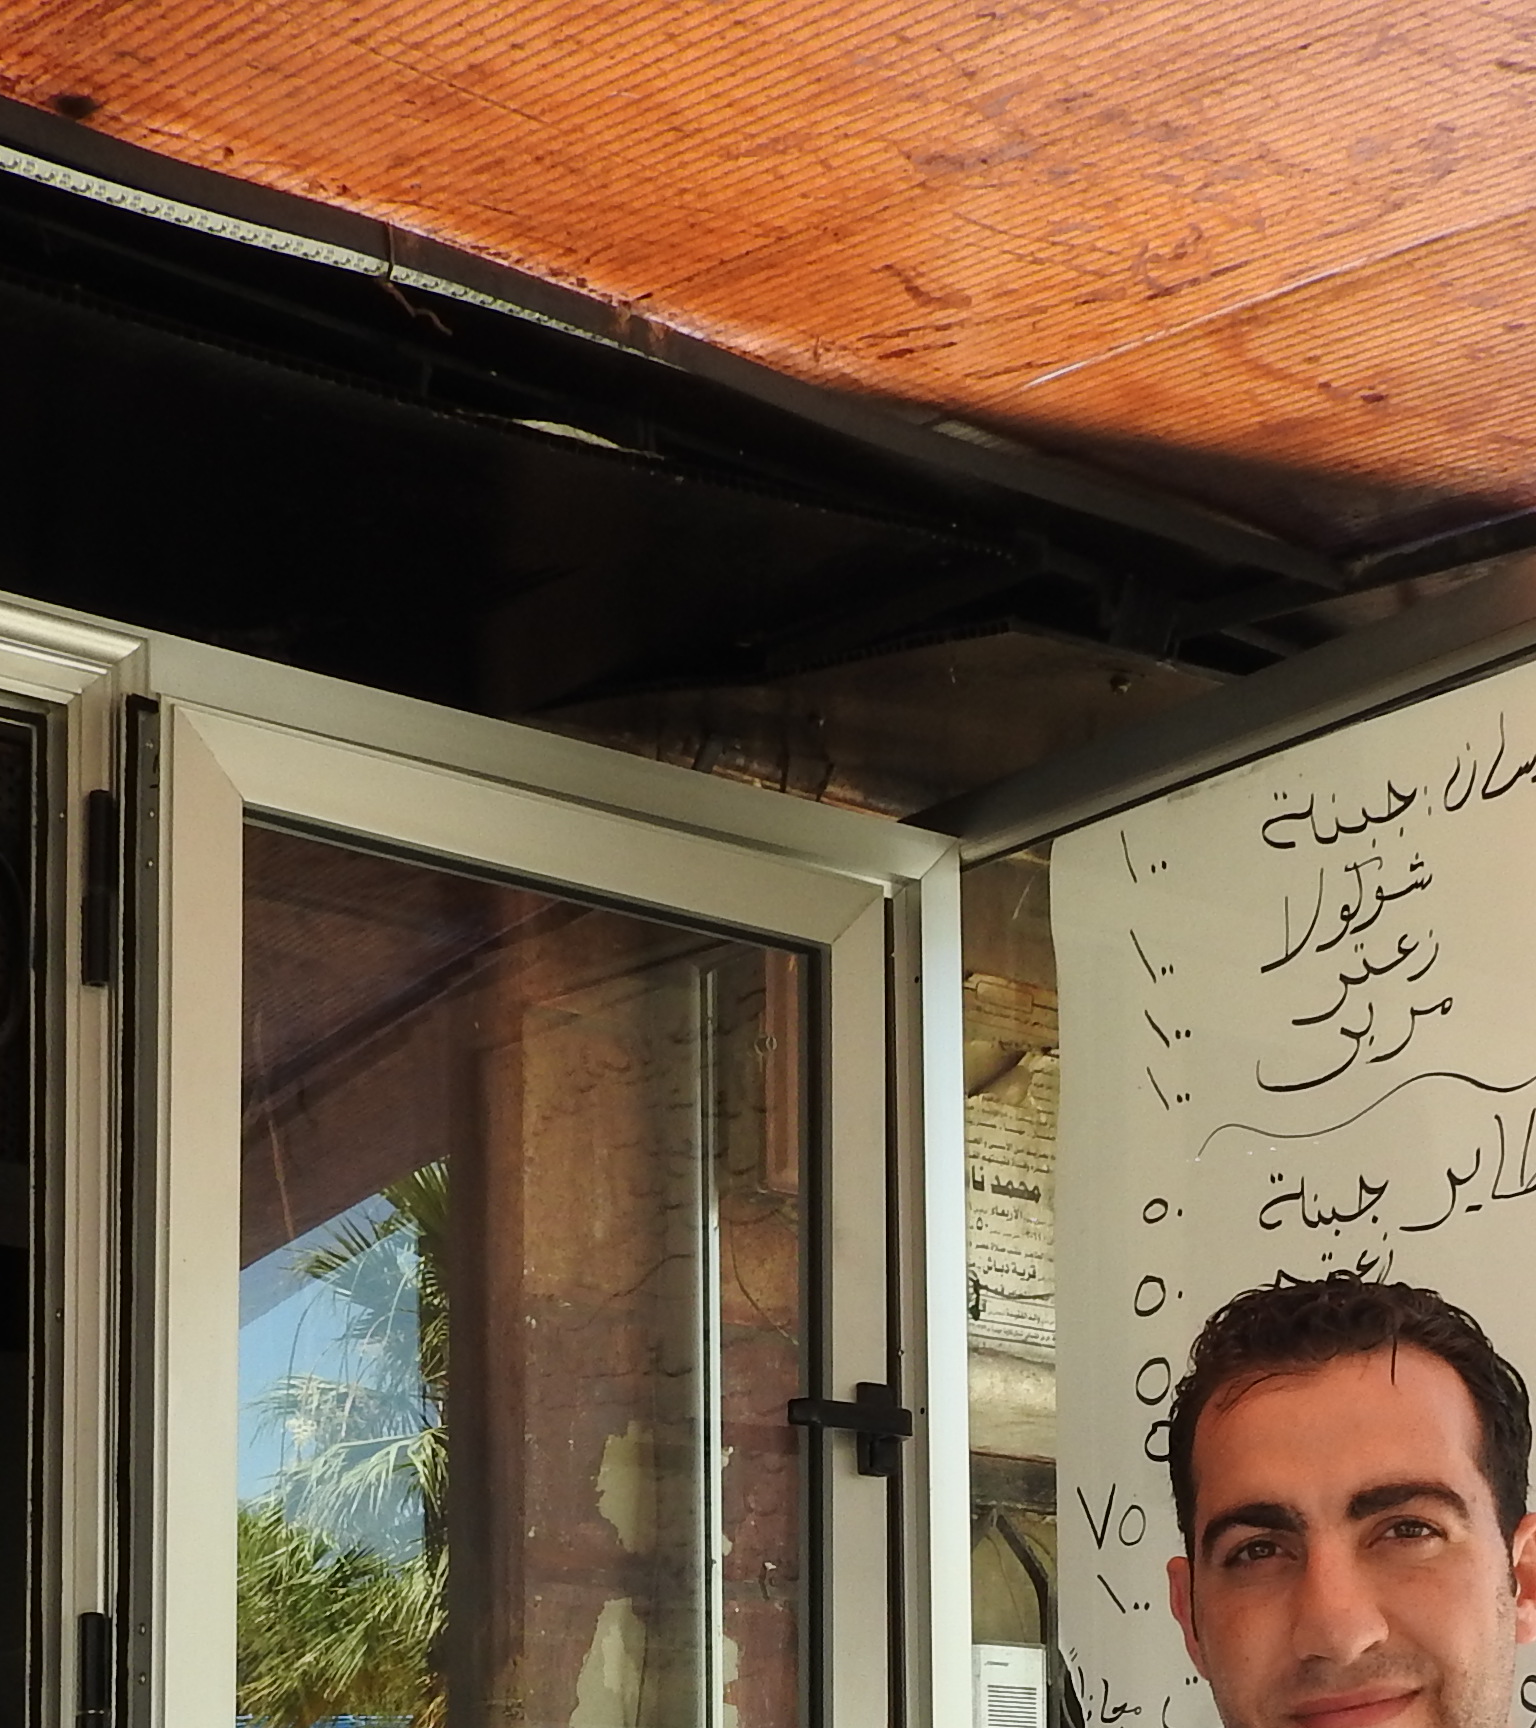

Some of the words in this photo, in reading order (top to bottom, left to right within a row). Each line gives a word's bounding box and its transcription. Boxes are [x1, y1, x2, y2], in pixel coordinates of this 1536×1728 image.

[1292, 929, 1439, 1026] زعتر
[991, 1175, 1041, 1203] محمد
[1135, 1357, 1171, 1405] ٥
[1144, 1420, 1171, 1462] ٥
